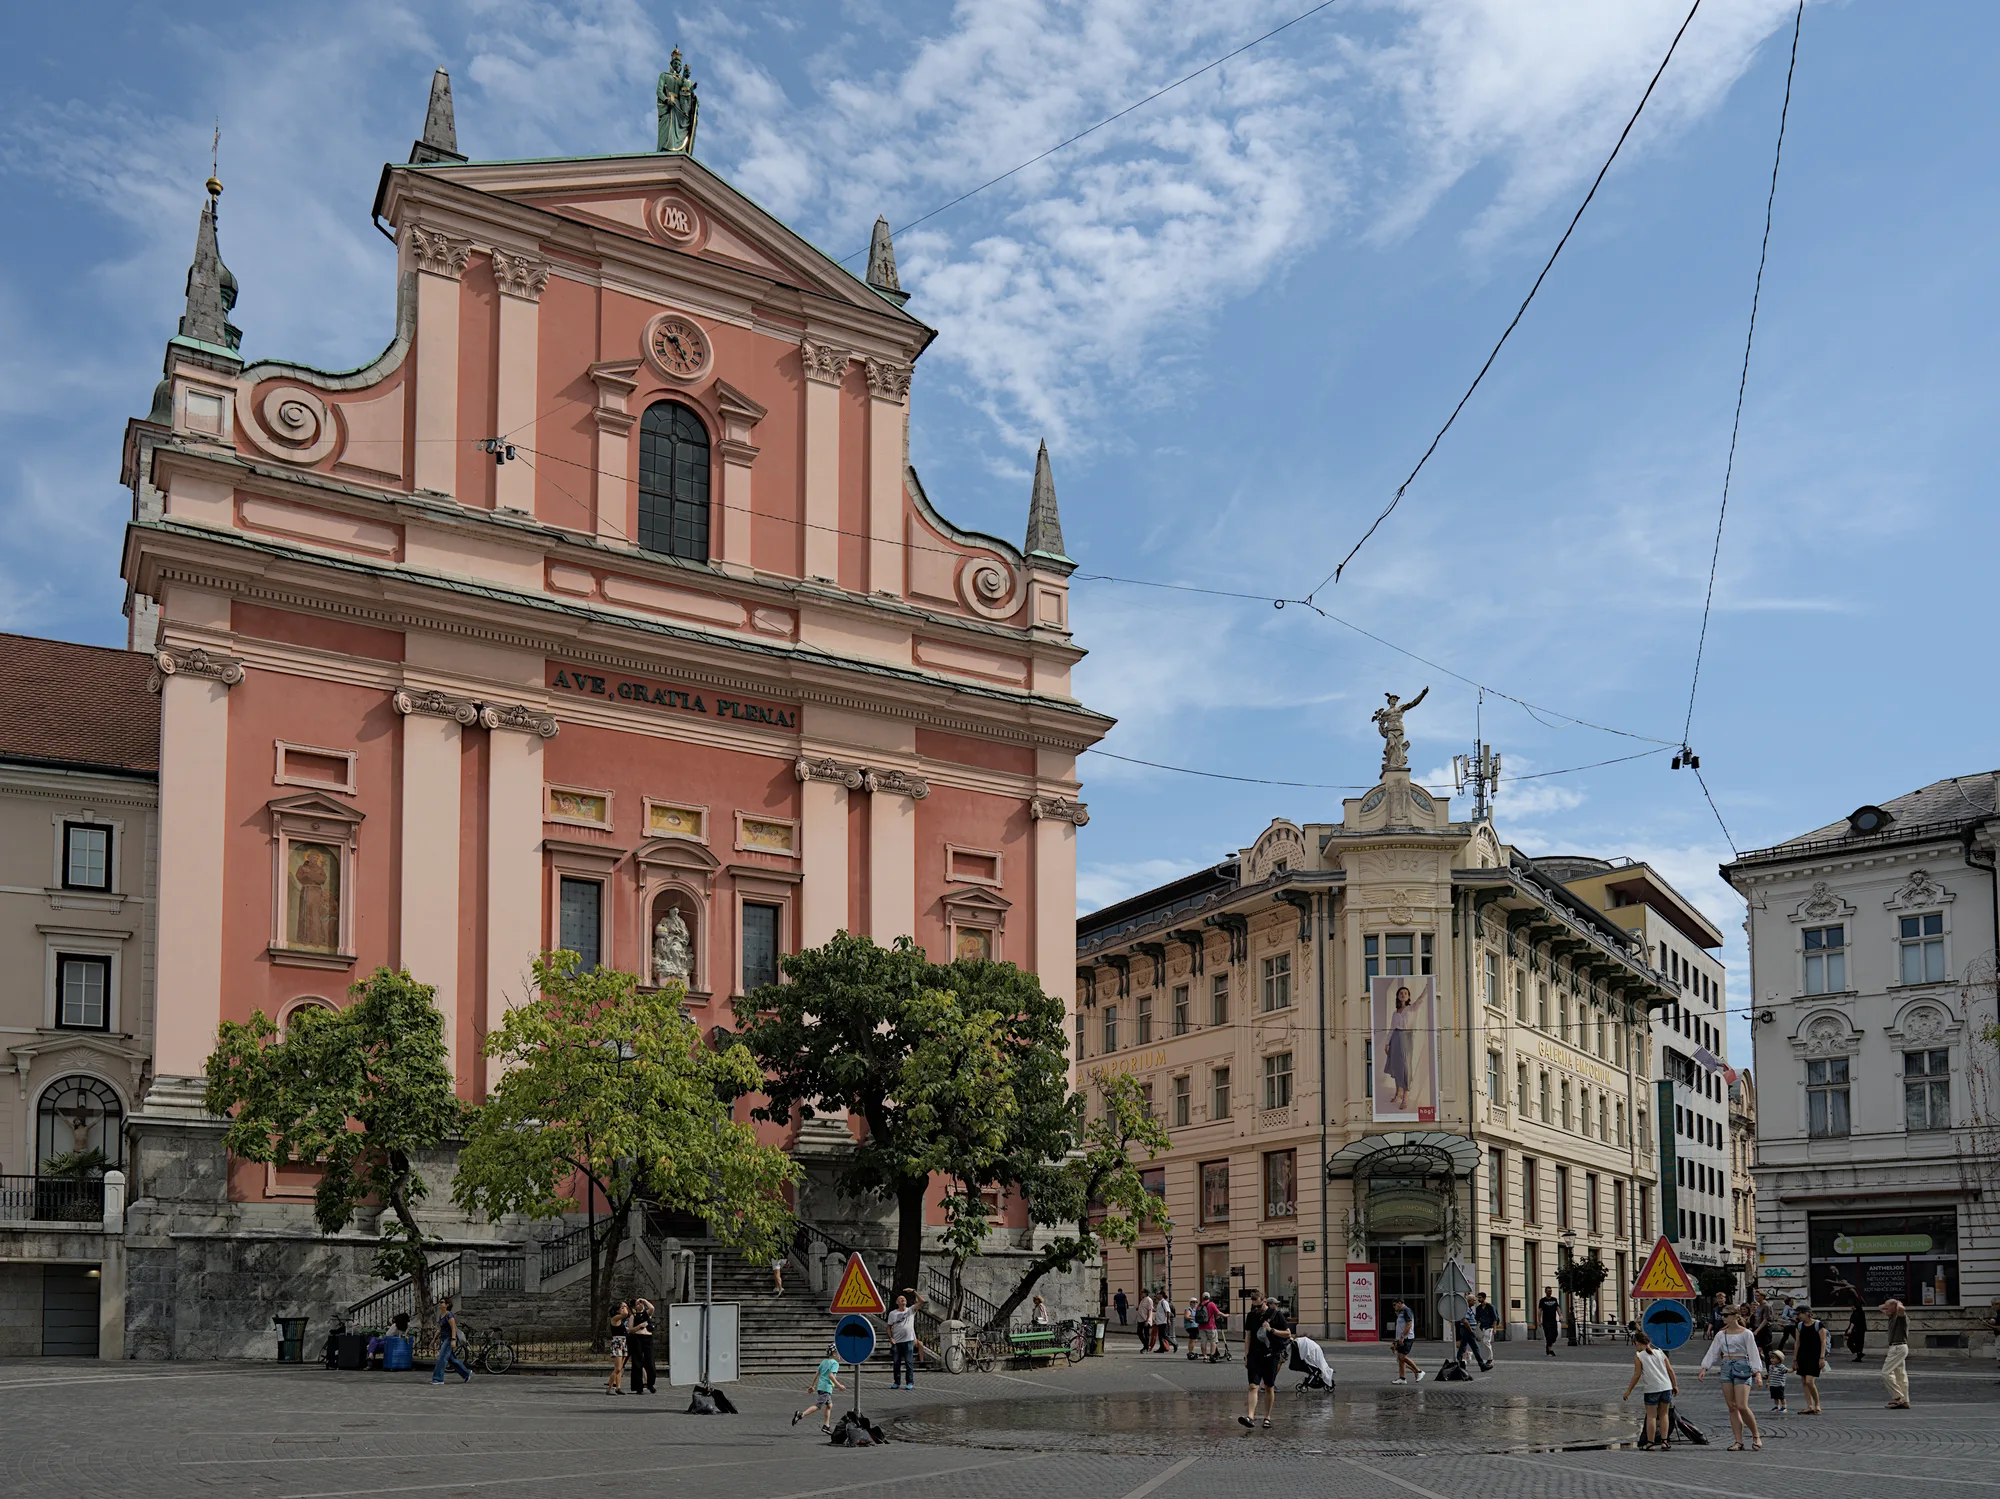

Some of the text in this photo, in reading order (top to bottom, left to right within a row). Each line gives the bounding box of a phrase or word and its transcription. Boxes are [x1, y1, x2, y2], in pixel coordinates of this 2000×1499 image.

[617, 681, 707, 712] GRATIA
[716, 698, 795, 728] PLENA!
[1538, 1039, 1612, 1086] GALERIJA EMPORIUM
[1856, 1239, 1930, 1249] LEKARNA LJUBLJANA
[1352, 1278, 1373, 1286] -40%
[1352, 1312, 1373, 1320] -40%
